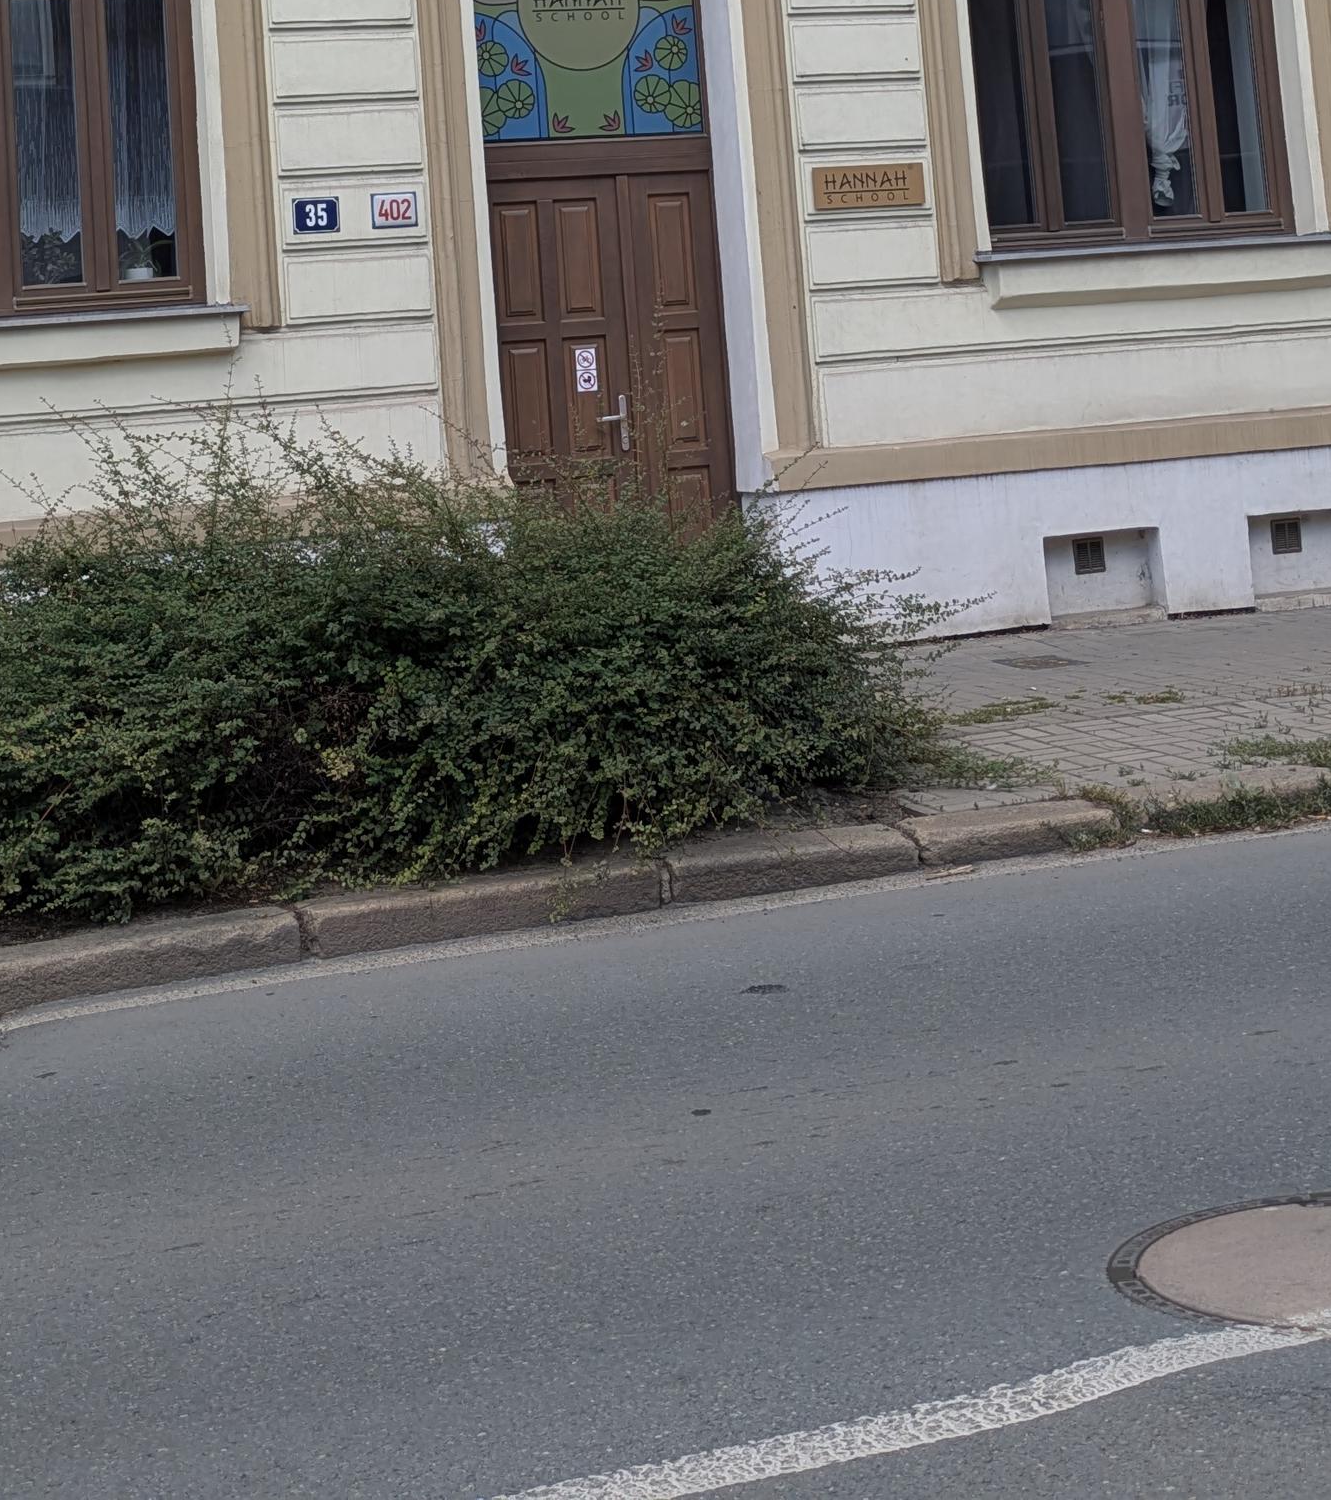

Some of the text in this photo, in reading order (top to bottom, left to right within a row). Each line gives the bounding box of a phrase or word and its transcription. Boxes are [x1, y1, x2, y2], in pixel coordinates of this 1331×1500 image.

[535, 11, 624, 22] SCHOOL
[824, 170, 907, 190] HANNAH
[827, 191, 909, 204] SCHOOL
[305, 203, 328, 227] 35
[378, 198, 412, 221] 402
